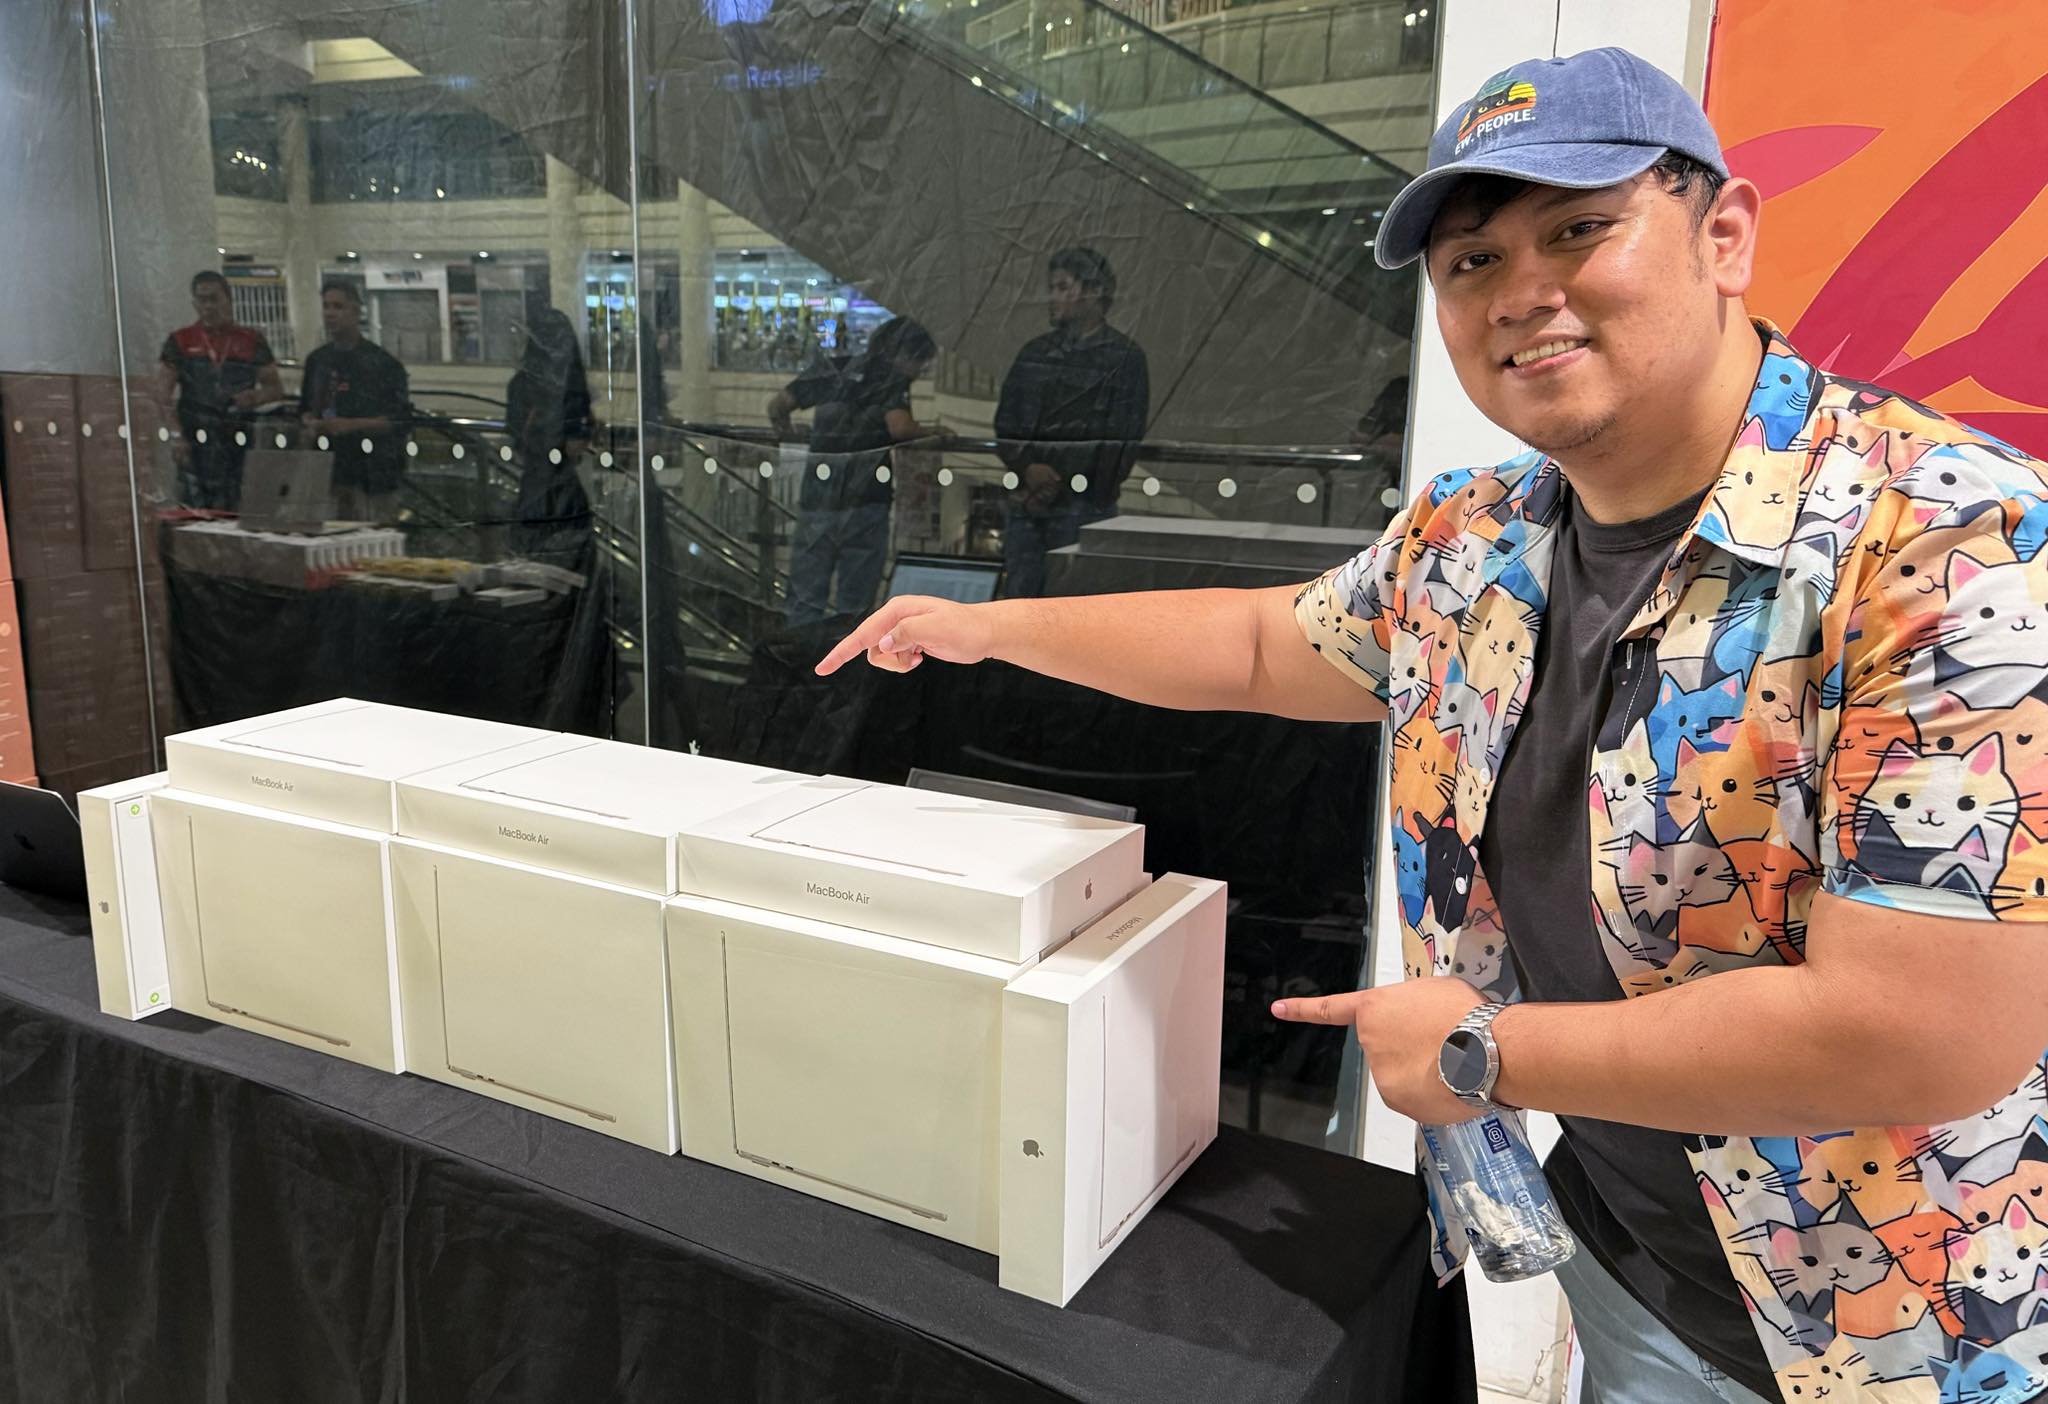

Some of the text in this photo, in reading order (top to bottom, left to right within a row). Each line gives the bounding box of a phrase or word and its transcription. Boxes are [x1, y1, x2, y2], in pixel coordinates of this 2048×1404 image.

[1476, 108, 1536, 138] PEOPLE.
[498, 825, 549, 845] MacBook Air
[806, 882, 871, 905] MacBook Air
